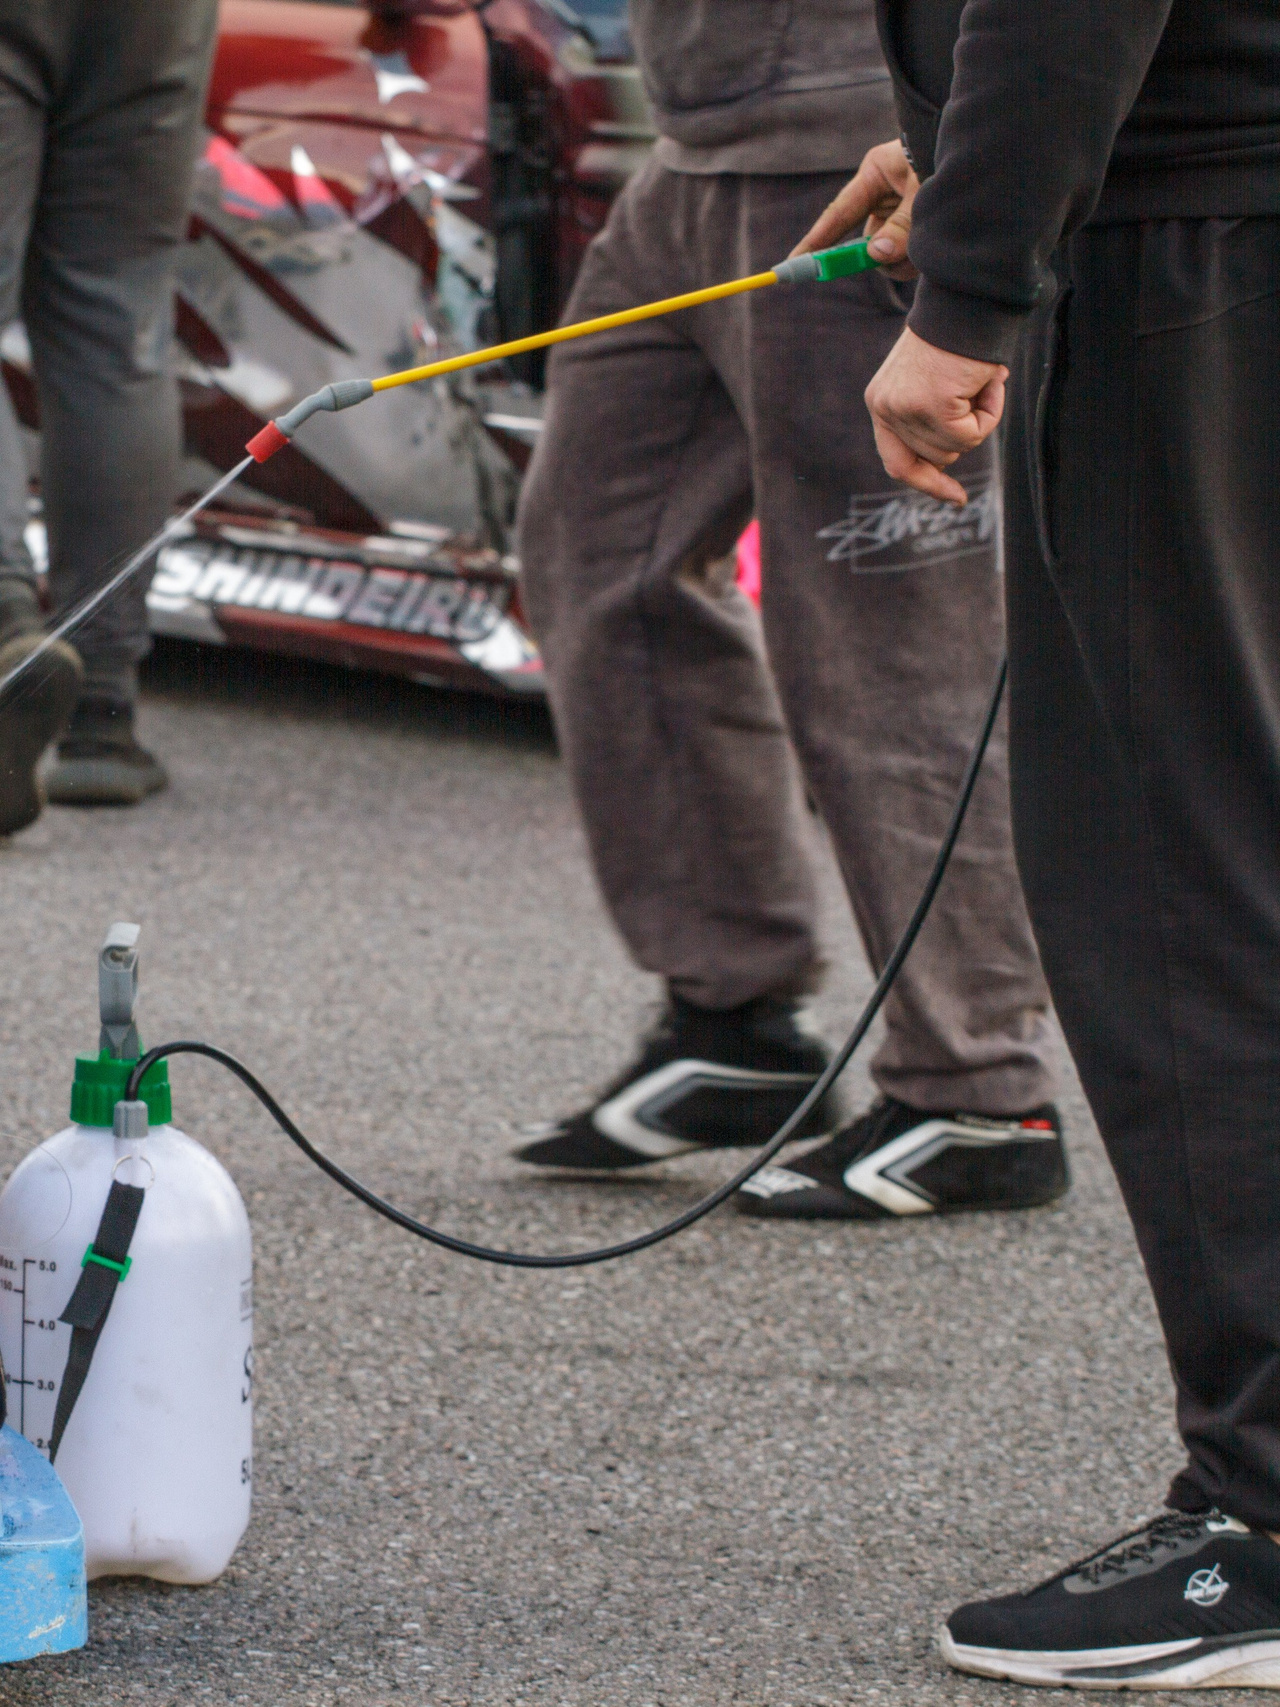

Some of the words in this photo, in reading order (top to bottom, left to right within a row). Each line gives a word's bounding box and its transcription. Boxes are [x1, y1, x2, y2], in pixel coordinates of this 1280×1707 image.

[39, 1260, 57, 1272] 5.0
[38, 1320, 56, 1331] 4.0
[37, 1379, 55, 1391] 3.0
